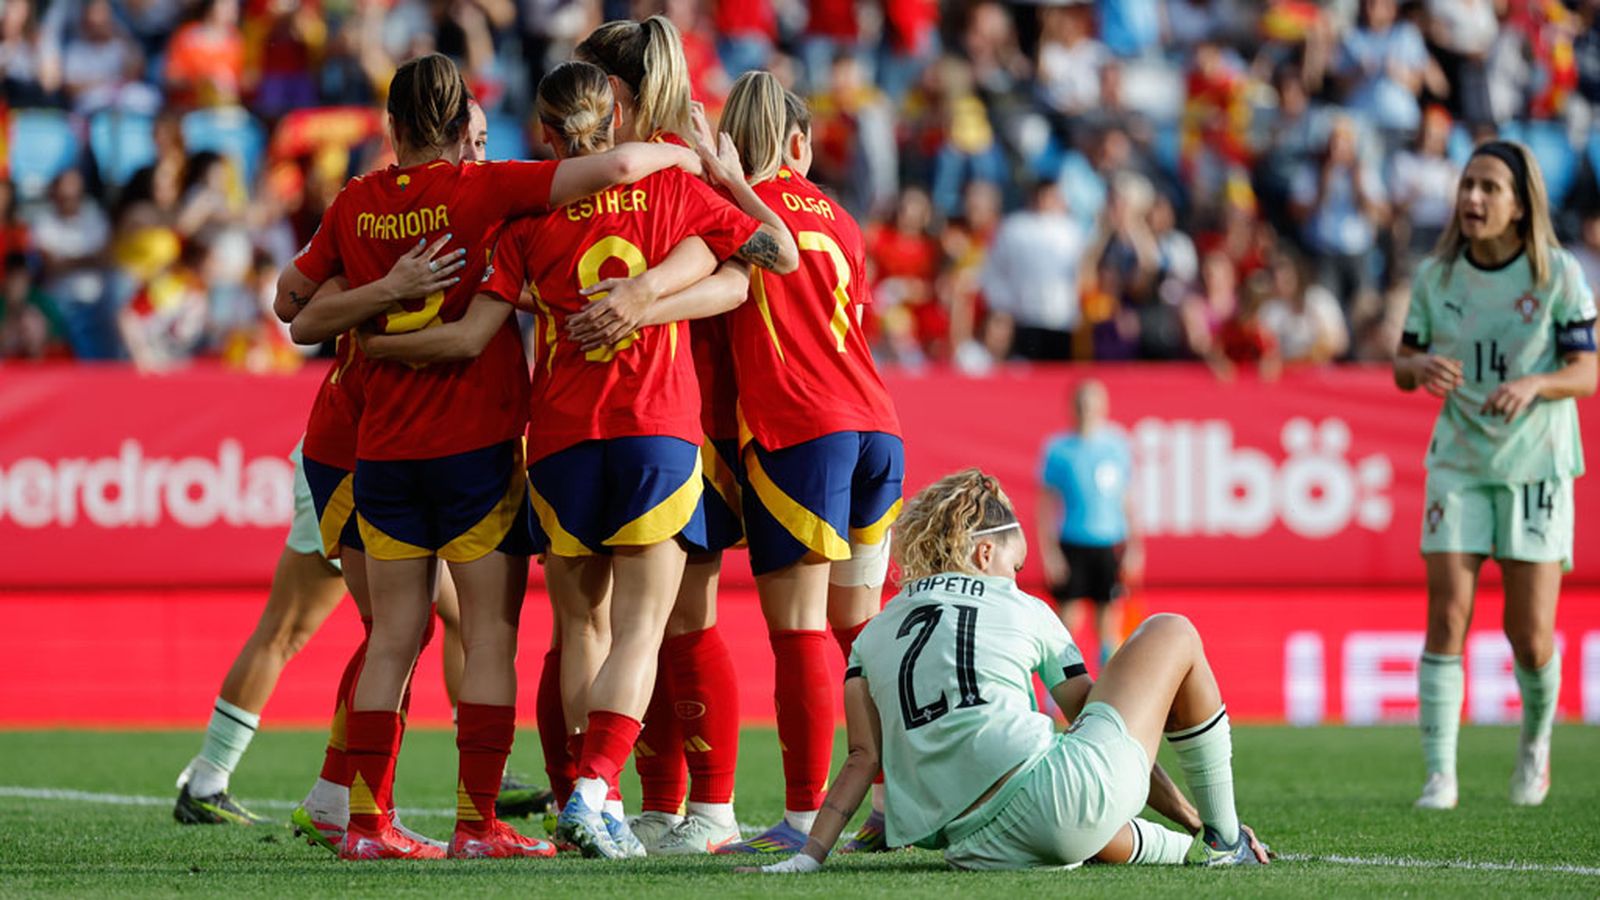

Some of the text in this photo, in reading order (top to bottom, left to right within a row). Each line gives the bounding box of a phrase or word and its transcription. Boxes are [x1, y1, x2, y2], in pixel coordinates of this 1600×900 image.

[357, 204, 449, 239] MARIONA
[567, 189, 648, 221] ESTHER
[782, 192, 835, 221] OLGA
[798, 231, 850, 353] 7
[1475, 341, 1507, 383] 14
[0, 438, 295, 528] erdrola
[1523, 480, 1553, 520] 14
[896, 603, 990, 730] 21
